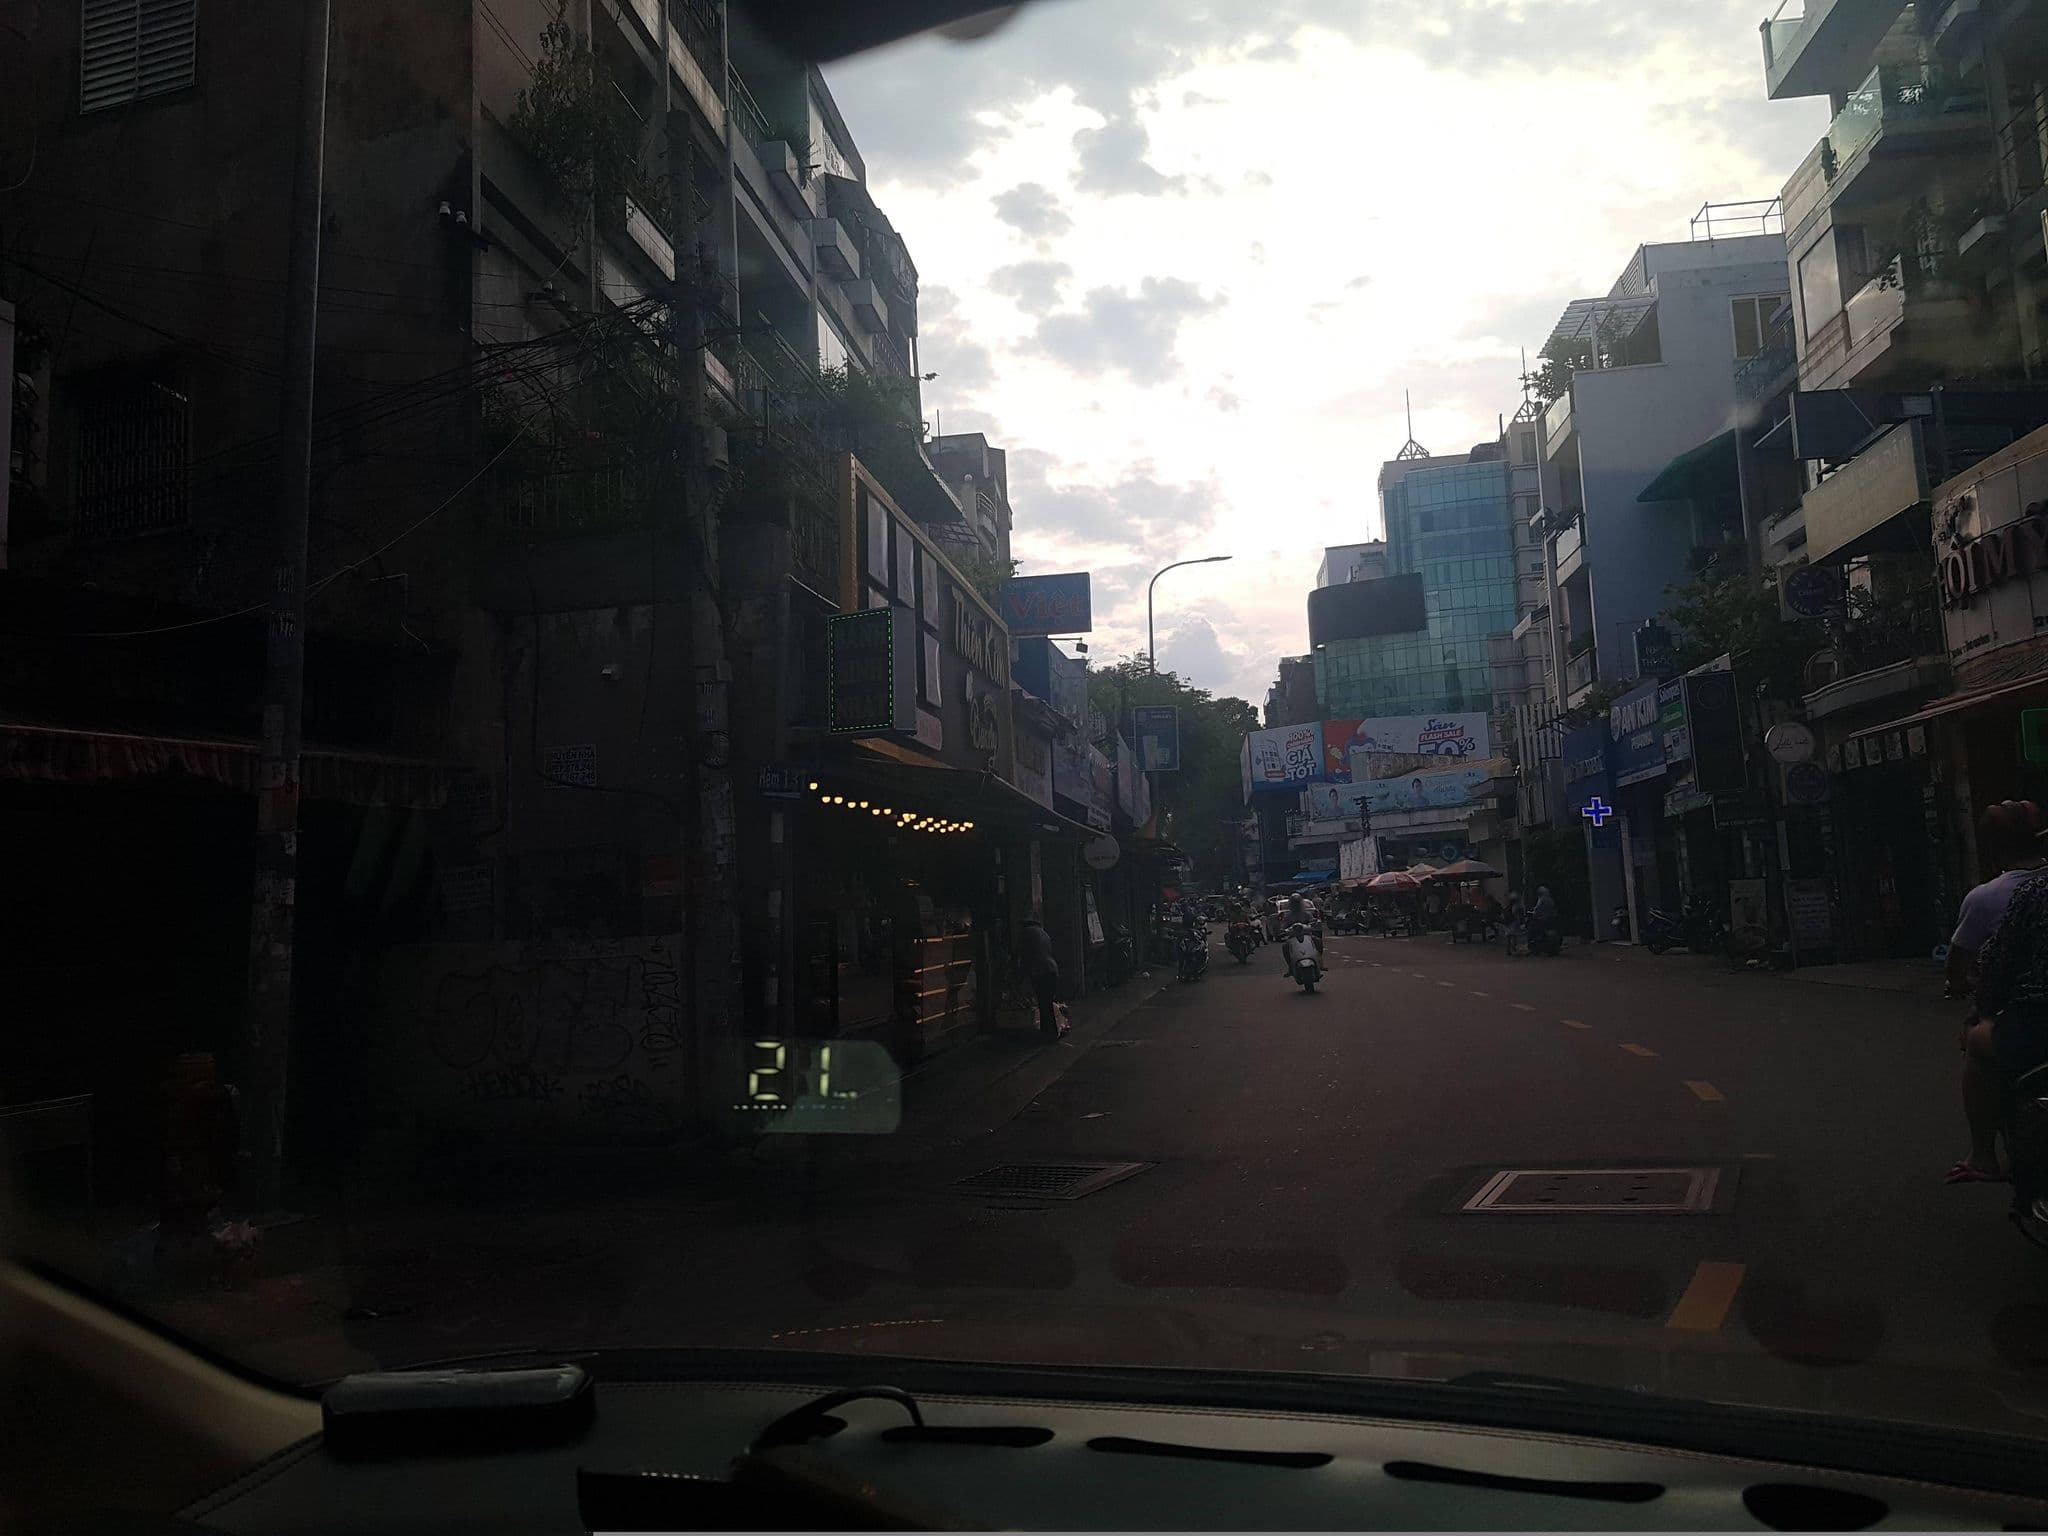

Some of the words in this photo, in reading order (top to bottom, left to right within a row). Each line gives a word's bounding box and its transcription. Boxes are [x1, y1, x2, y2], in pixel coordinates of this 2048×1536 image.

[985, 620, 1008, 689] Kim
[1420, 733, 1442, 742] FLASH
[1443, 731, 1461, 739] SALE
[1287, 745, 1313, 765] GIÁ
[1287, 763, 1316, 780] TỐT
[749, 1041, 831, 1102] 21
